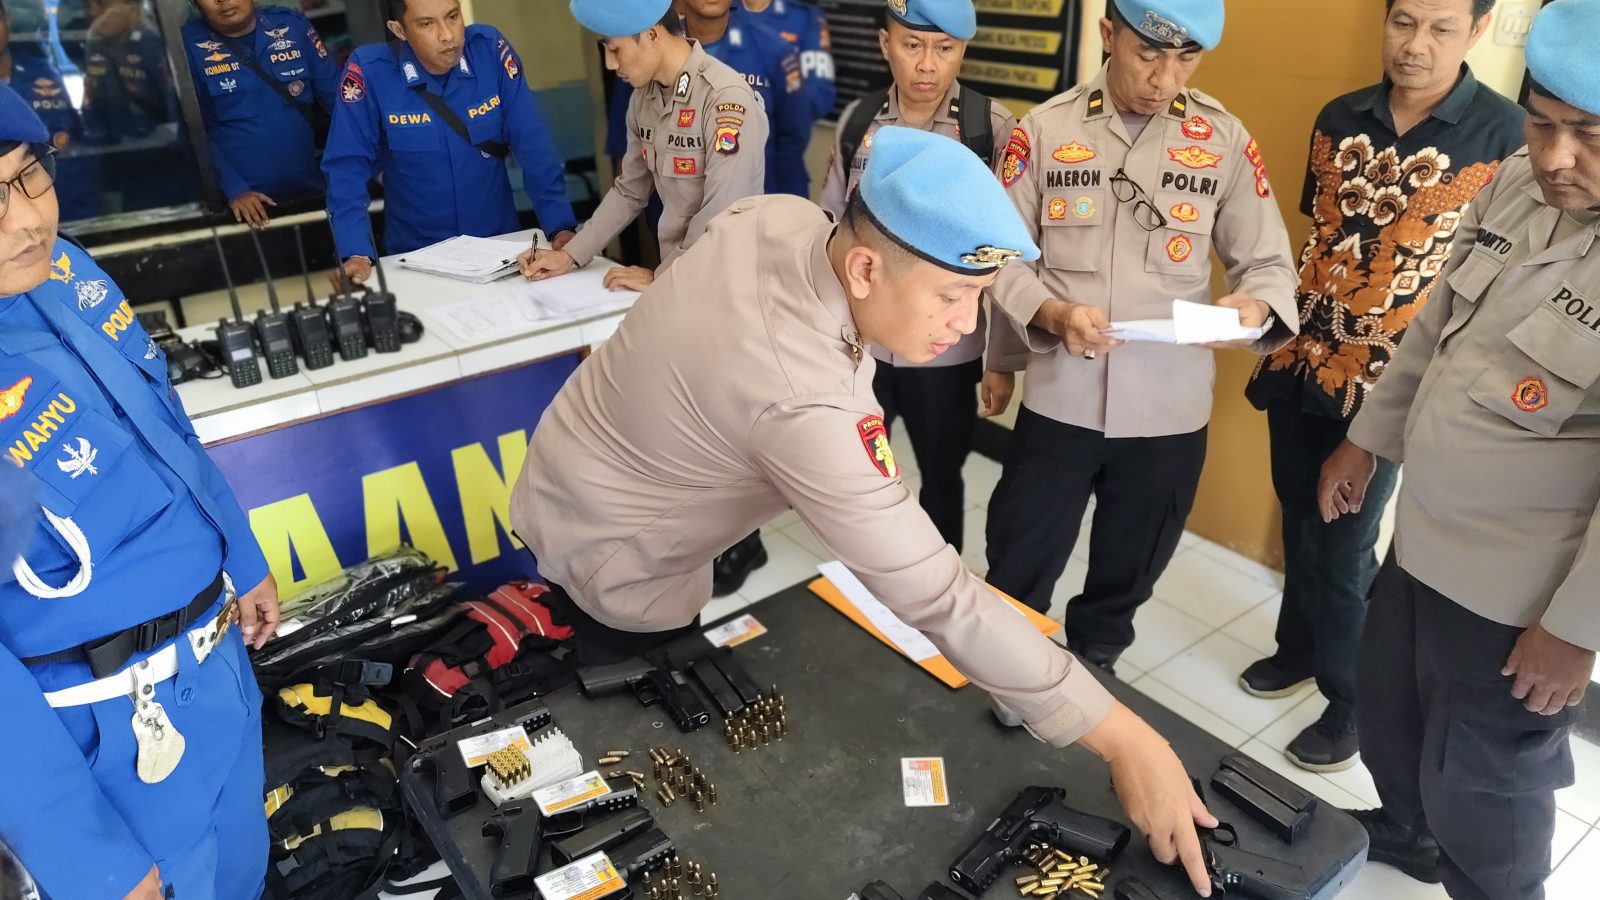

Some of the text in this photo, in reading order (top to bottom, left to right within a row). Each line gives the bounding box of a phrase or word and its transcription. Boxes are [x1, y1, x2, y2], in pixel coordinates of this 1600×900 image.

[270, 49, 302, 64] POLRI
[204, 63, 232, 77] KOMANG
[468, 95, 501, 119] POLRI
[718, 104, 744, 113] POLDA
[388, 112, 432, 125] DEWA
[668, 134, 702, 148] POLRI
[1047, 169, 1101, 188] HAERON
[1162, 171, 1218, 196] POLRI
[3, 392, 77, 469] WAHYU
